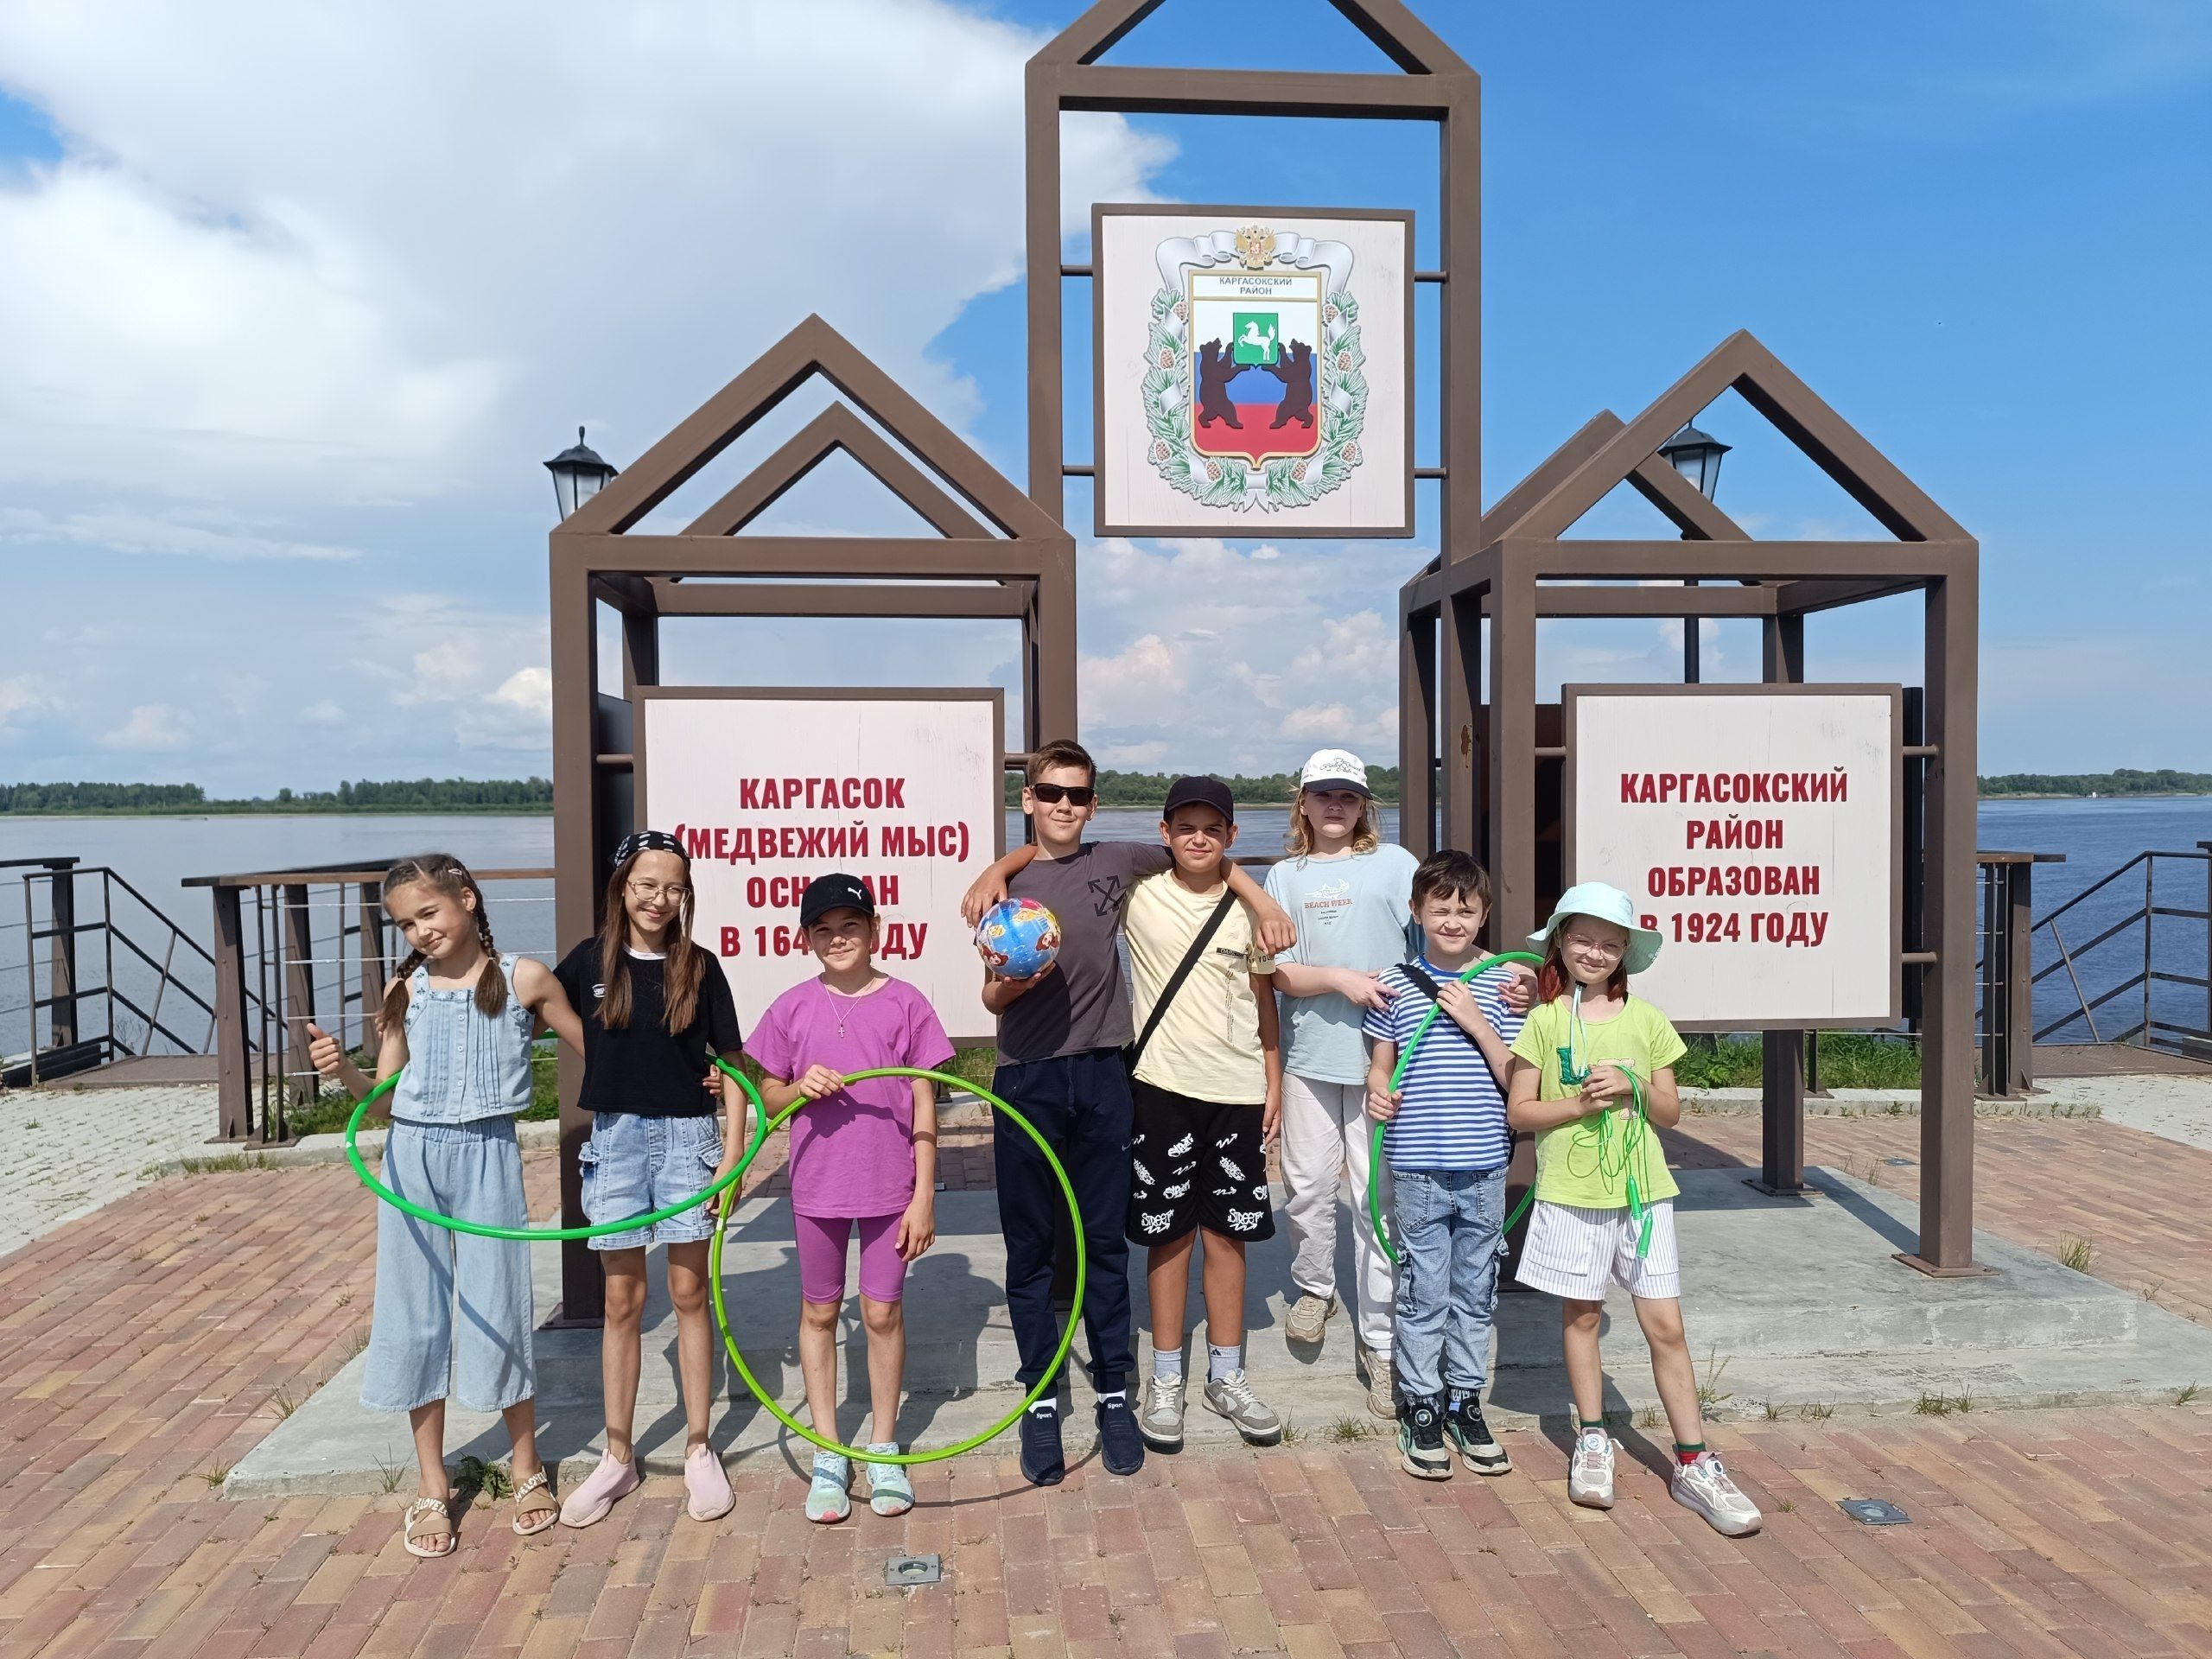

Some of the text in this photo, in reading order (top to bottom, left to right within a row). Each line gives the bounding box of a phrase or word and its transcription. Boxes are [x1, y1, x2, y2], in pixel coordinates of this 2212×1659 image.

[1240, 286, 1272, 296] РАЙОН
[740, 779, 905, 810] КАРГАСОК
[1621, 766, 1848, 804] КАРГАСОКСКИЙ
[674, 820, 969, 865] (МЕДВЕЖИЙ МЫС)
[1687, 813, 1784, 849] РАЙОН
[747, 874, 899, 908] ОСНН
[1648, 866, 1821, 898] ОБРАЗОВАН
[1331, 899, 1353, 907] WEEK
[721, 923, 929, 961] В 164 ДУ
[1671, 912, 1741, 943] 1924
[1751, 912, 1828, 948] ГОДУ
[1036, 1411, 1053, 1420] Sport
